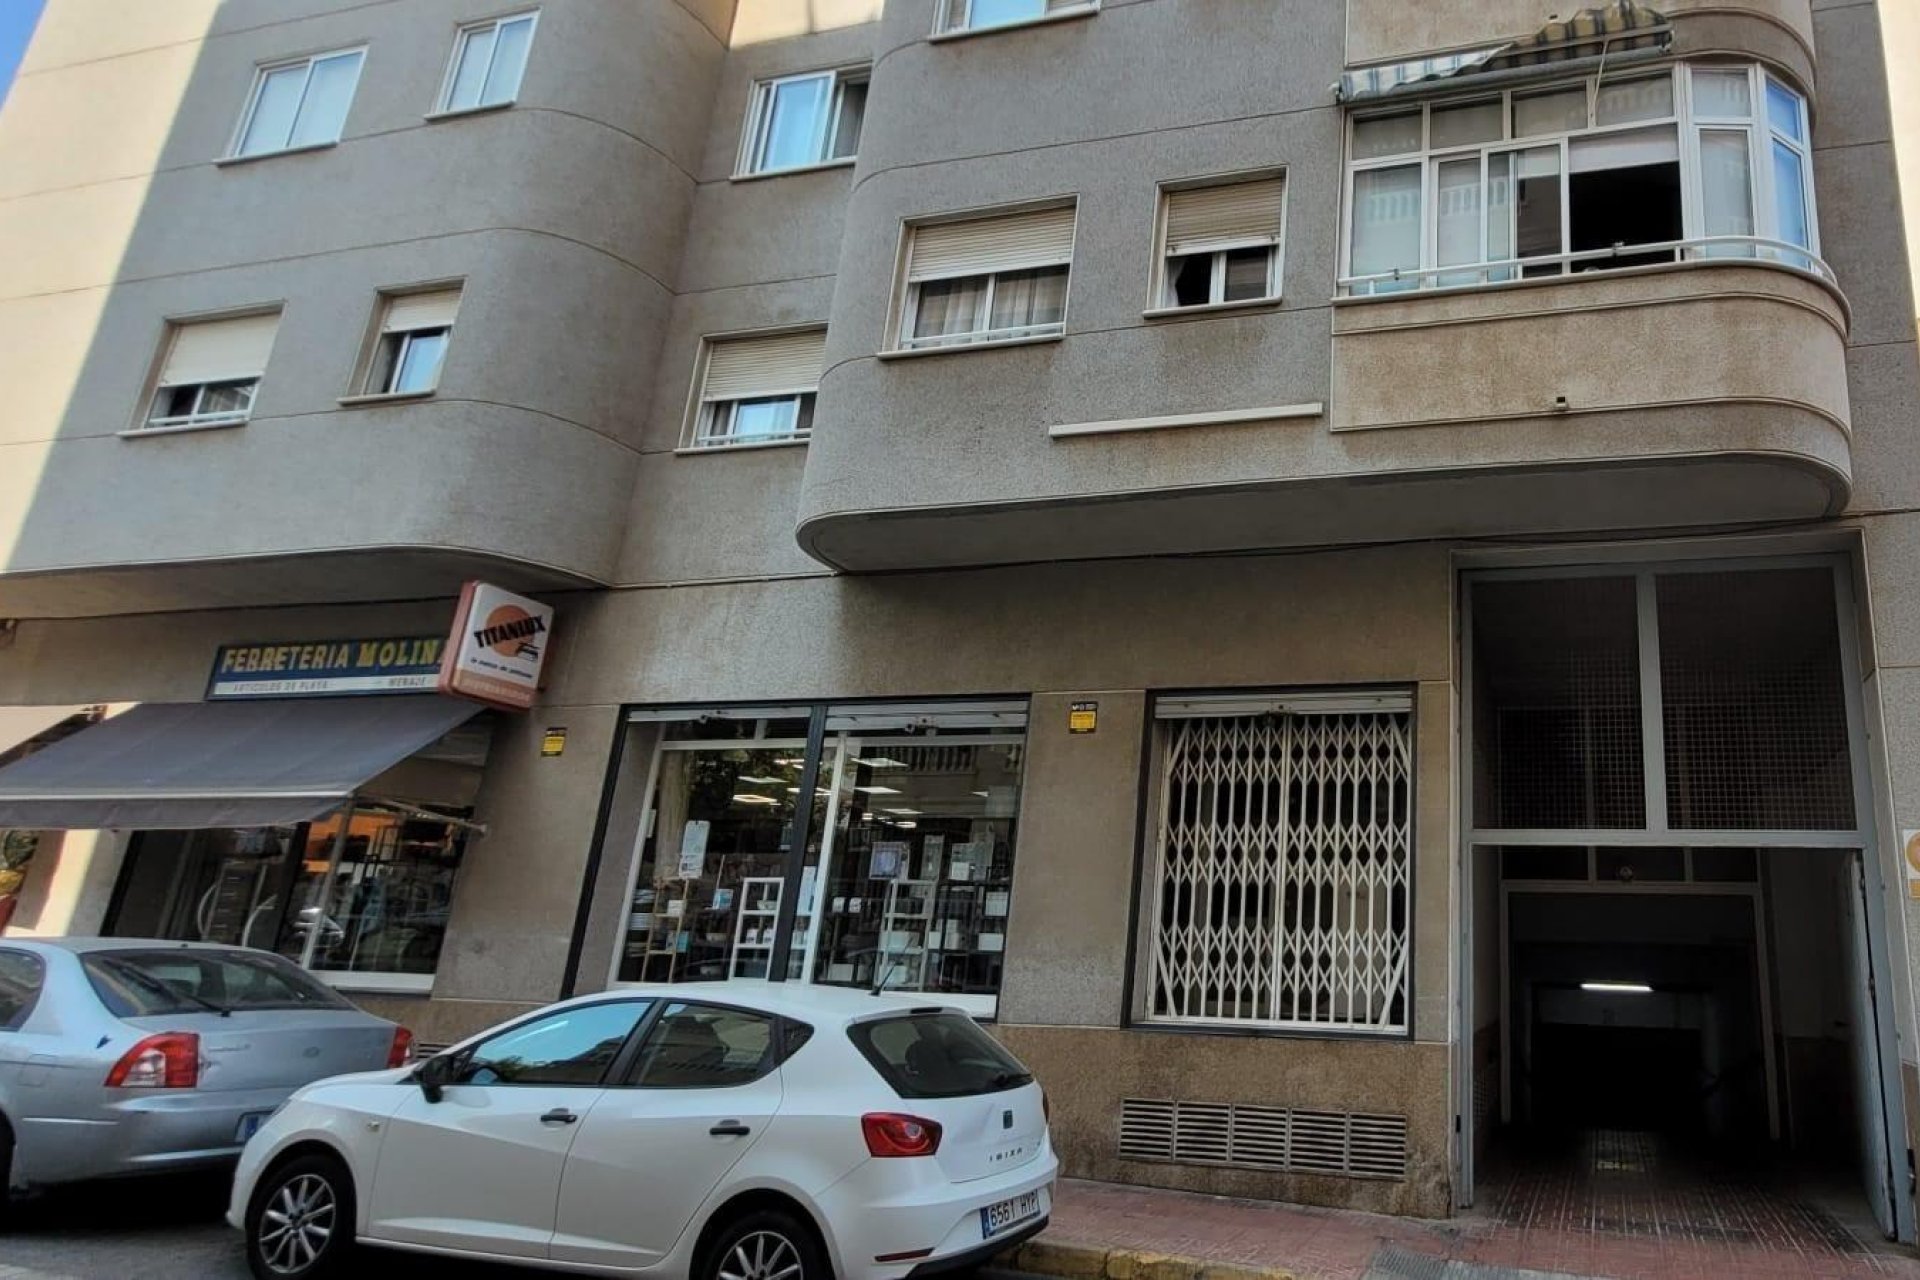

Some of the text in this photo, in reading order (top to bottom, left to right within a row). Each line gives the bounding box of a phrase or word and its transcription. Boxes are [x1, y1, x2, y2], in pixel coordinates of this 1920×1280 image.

[473, 615, 546, 649] TITANLUX
[221, 643, 350, 673] FERRETERIA
[355, 639, 443, 668] MOLIN
[989, 1147, 1023, 1162] IBIZA
[990, 1198, 1015, 1227] 6561
